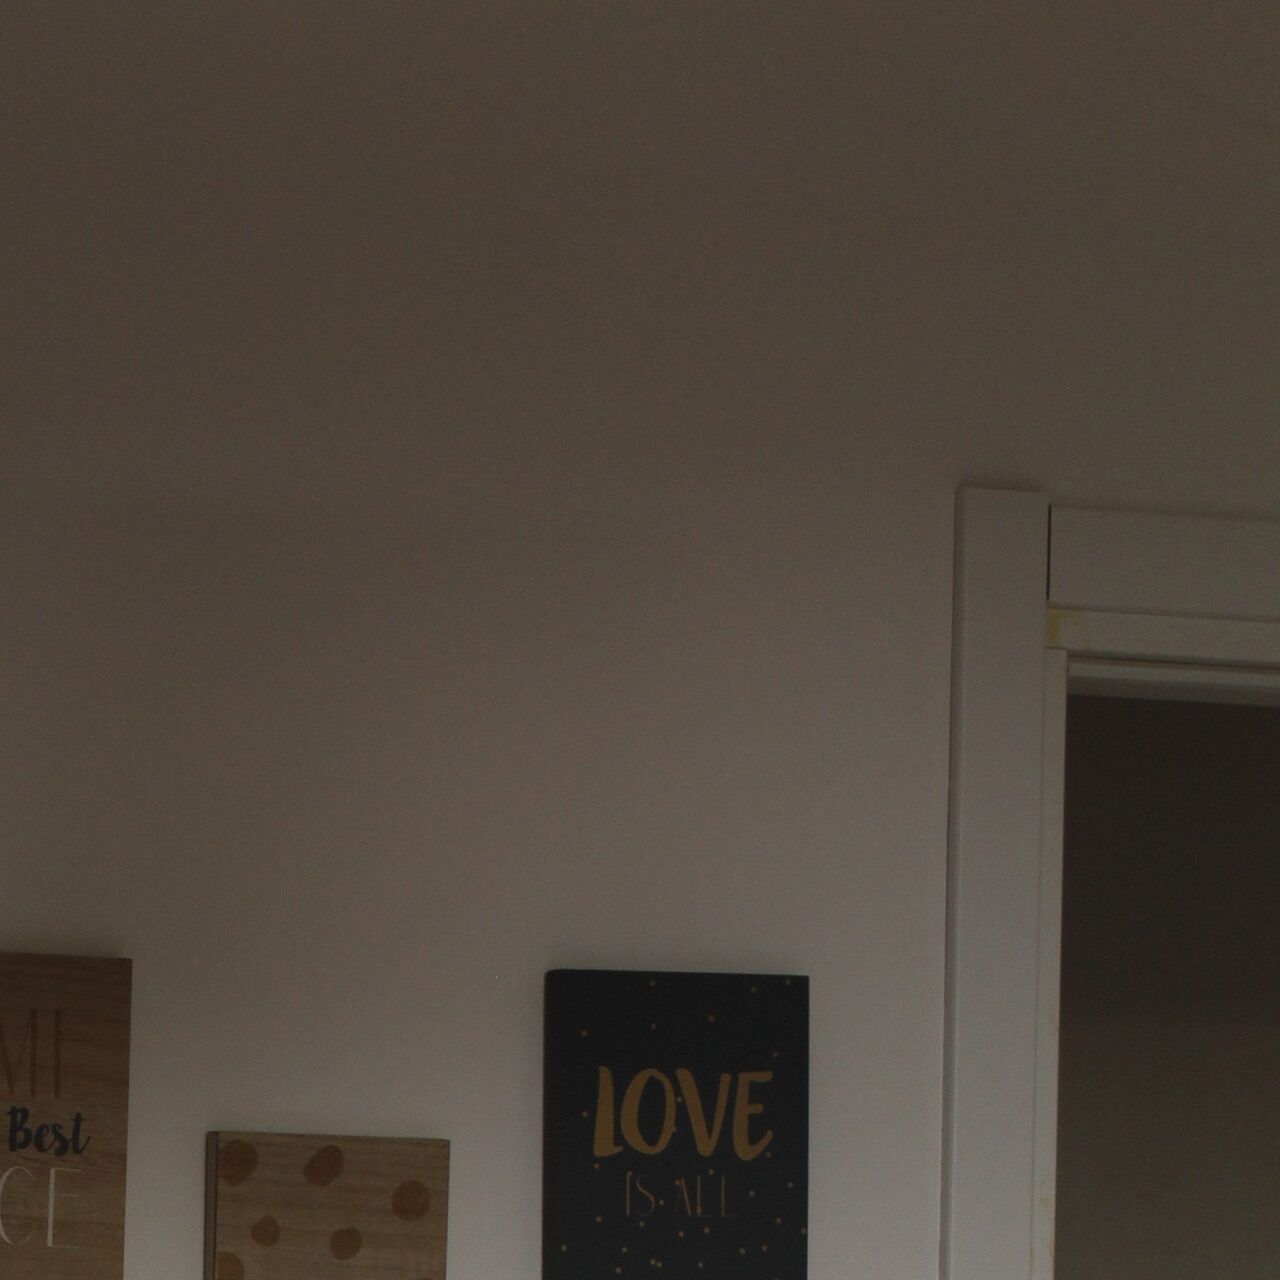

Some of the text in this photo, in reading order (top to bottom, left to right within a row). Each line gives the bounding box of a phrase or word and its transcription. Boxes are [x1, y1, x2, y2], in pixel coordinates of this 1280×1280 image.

[6, 1105, 92, 1157] Best
[593, 1064, 774, 1162] LOVE
[625, 1170, 656, 1218] IS
